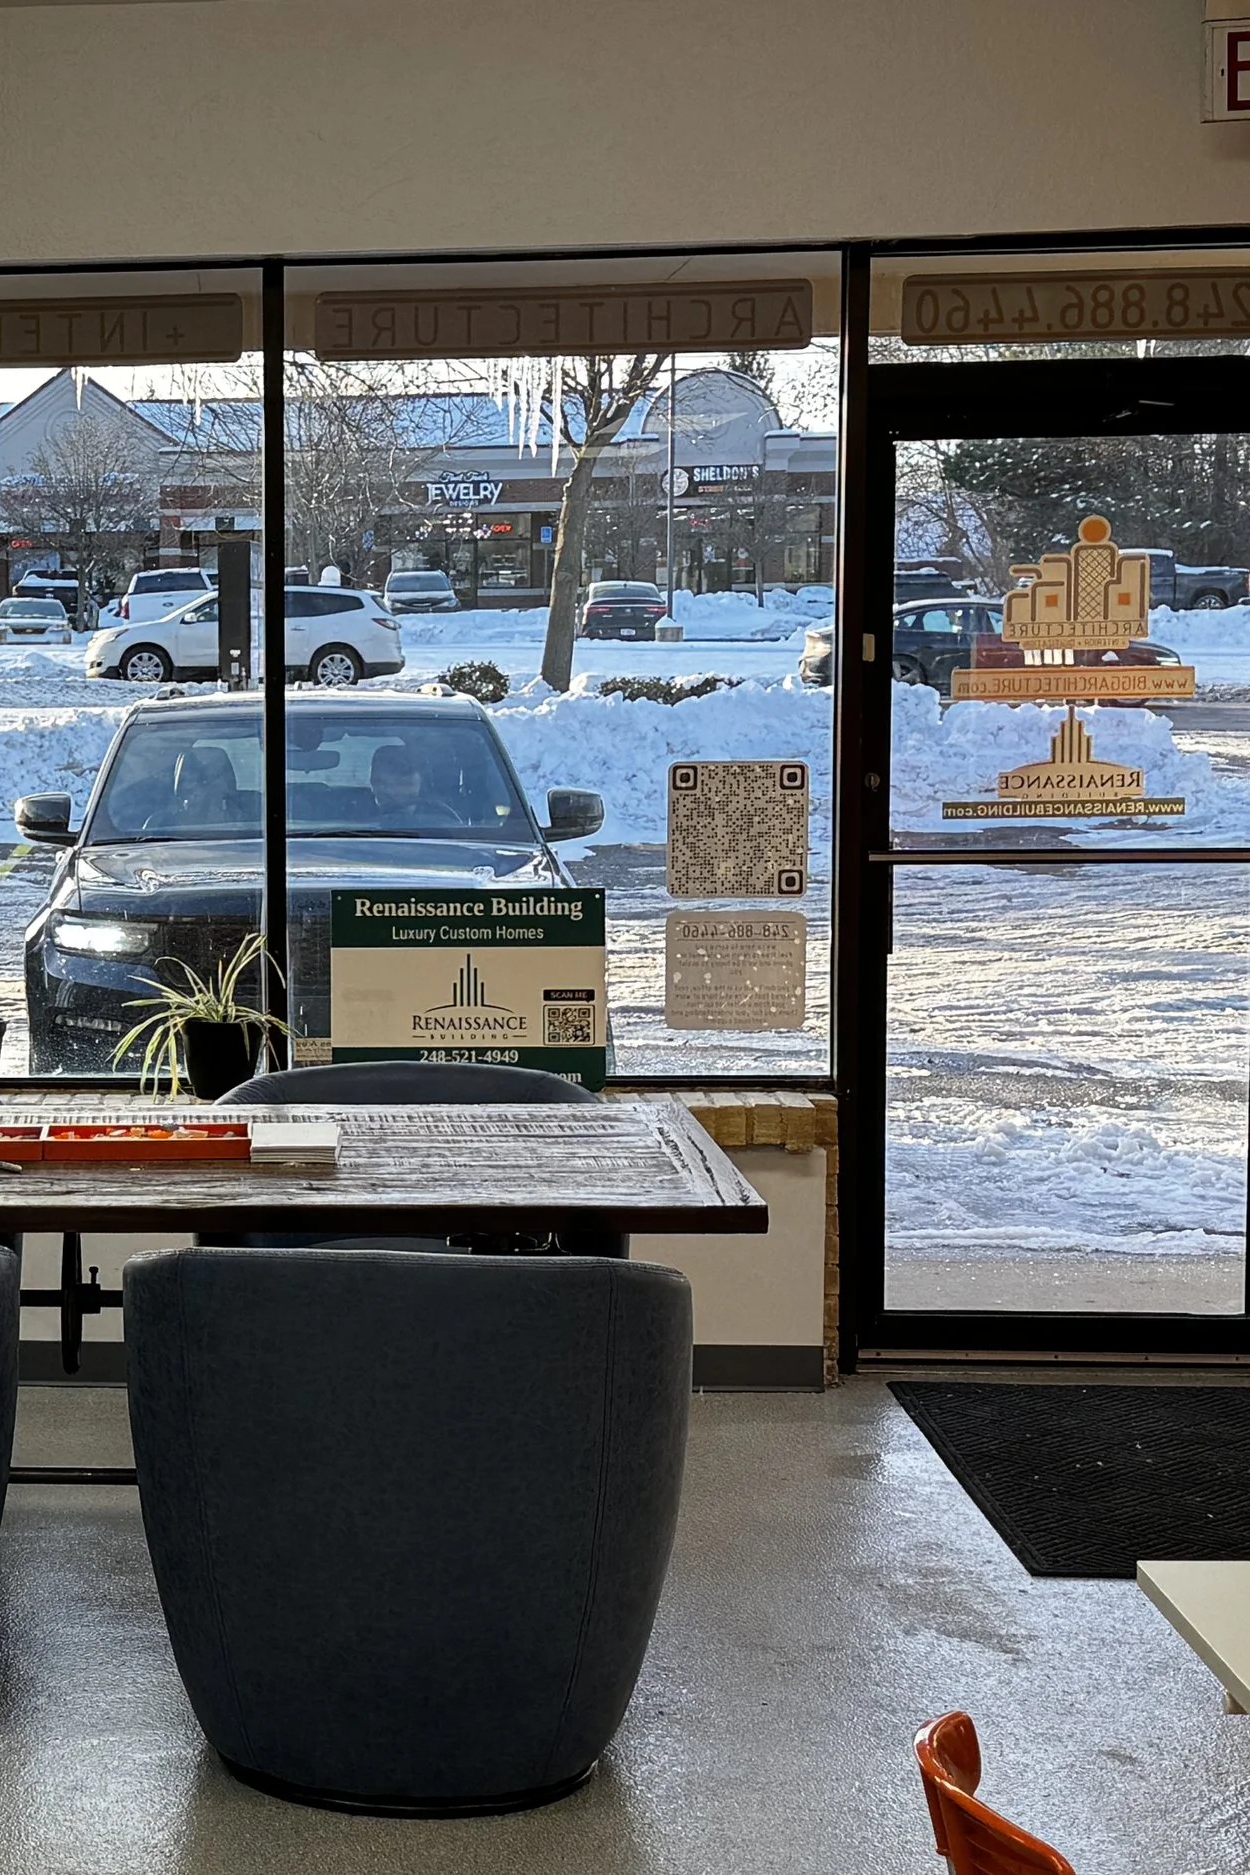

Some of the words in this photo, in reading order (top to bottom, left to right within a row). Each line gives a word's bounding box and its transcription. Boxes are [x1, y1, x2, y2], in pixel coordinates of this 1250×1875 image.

[693, 466, 759, 482] SHELDON'S
[355, 897, 484, 917] Renaissance
[491, 897, 583, 920] Building
[392, 926, 436, 943] Luxury
[440, 925, 492, 940] Custom
[496, 926, 544, 940] Homes
[551, 991, 573, 999] SCAN
[575, 991, 588, 999] ME
[412, 1015, 527, 1031] RENAISSANCE
[420, 1050, 519, 1064] 248-521-4949
